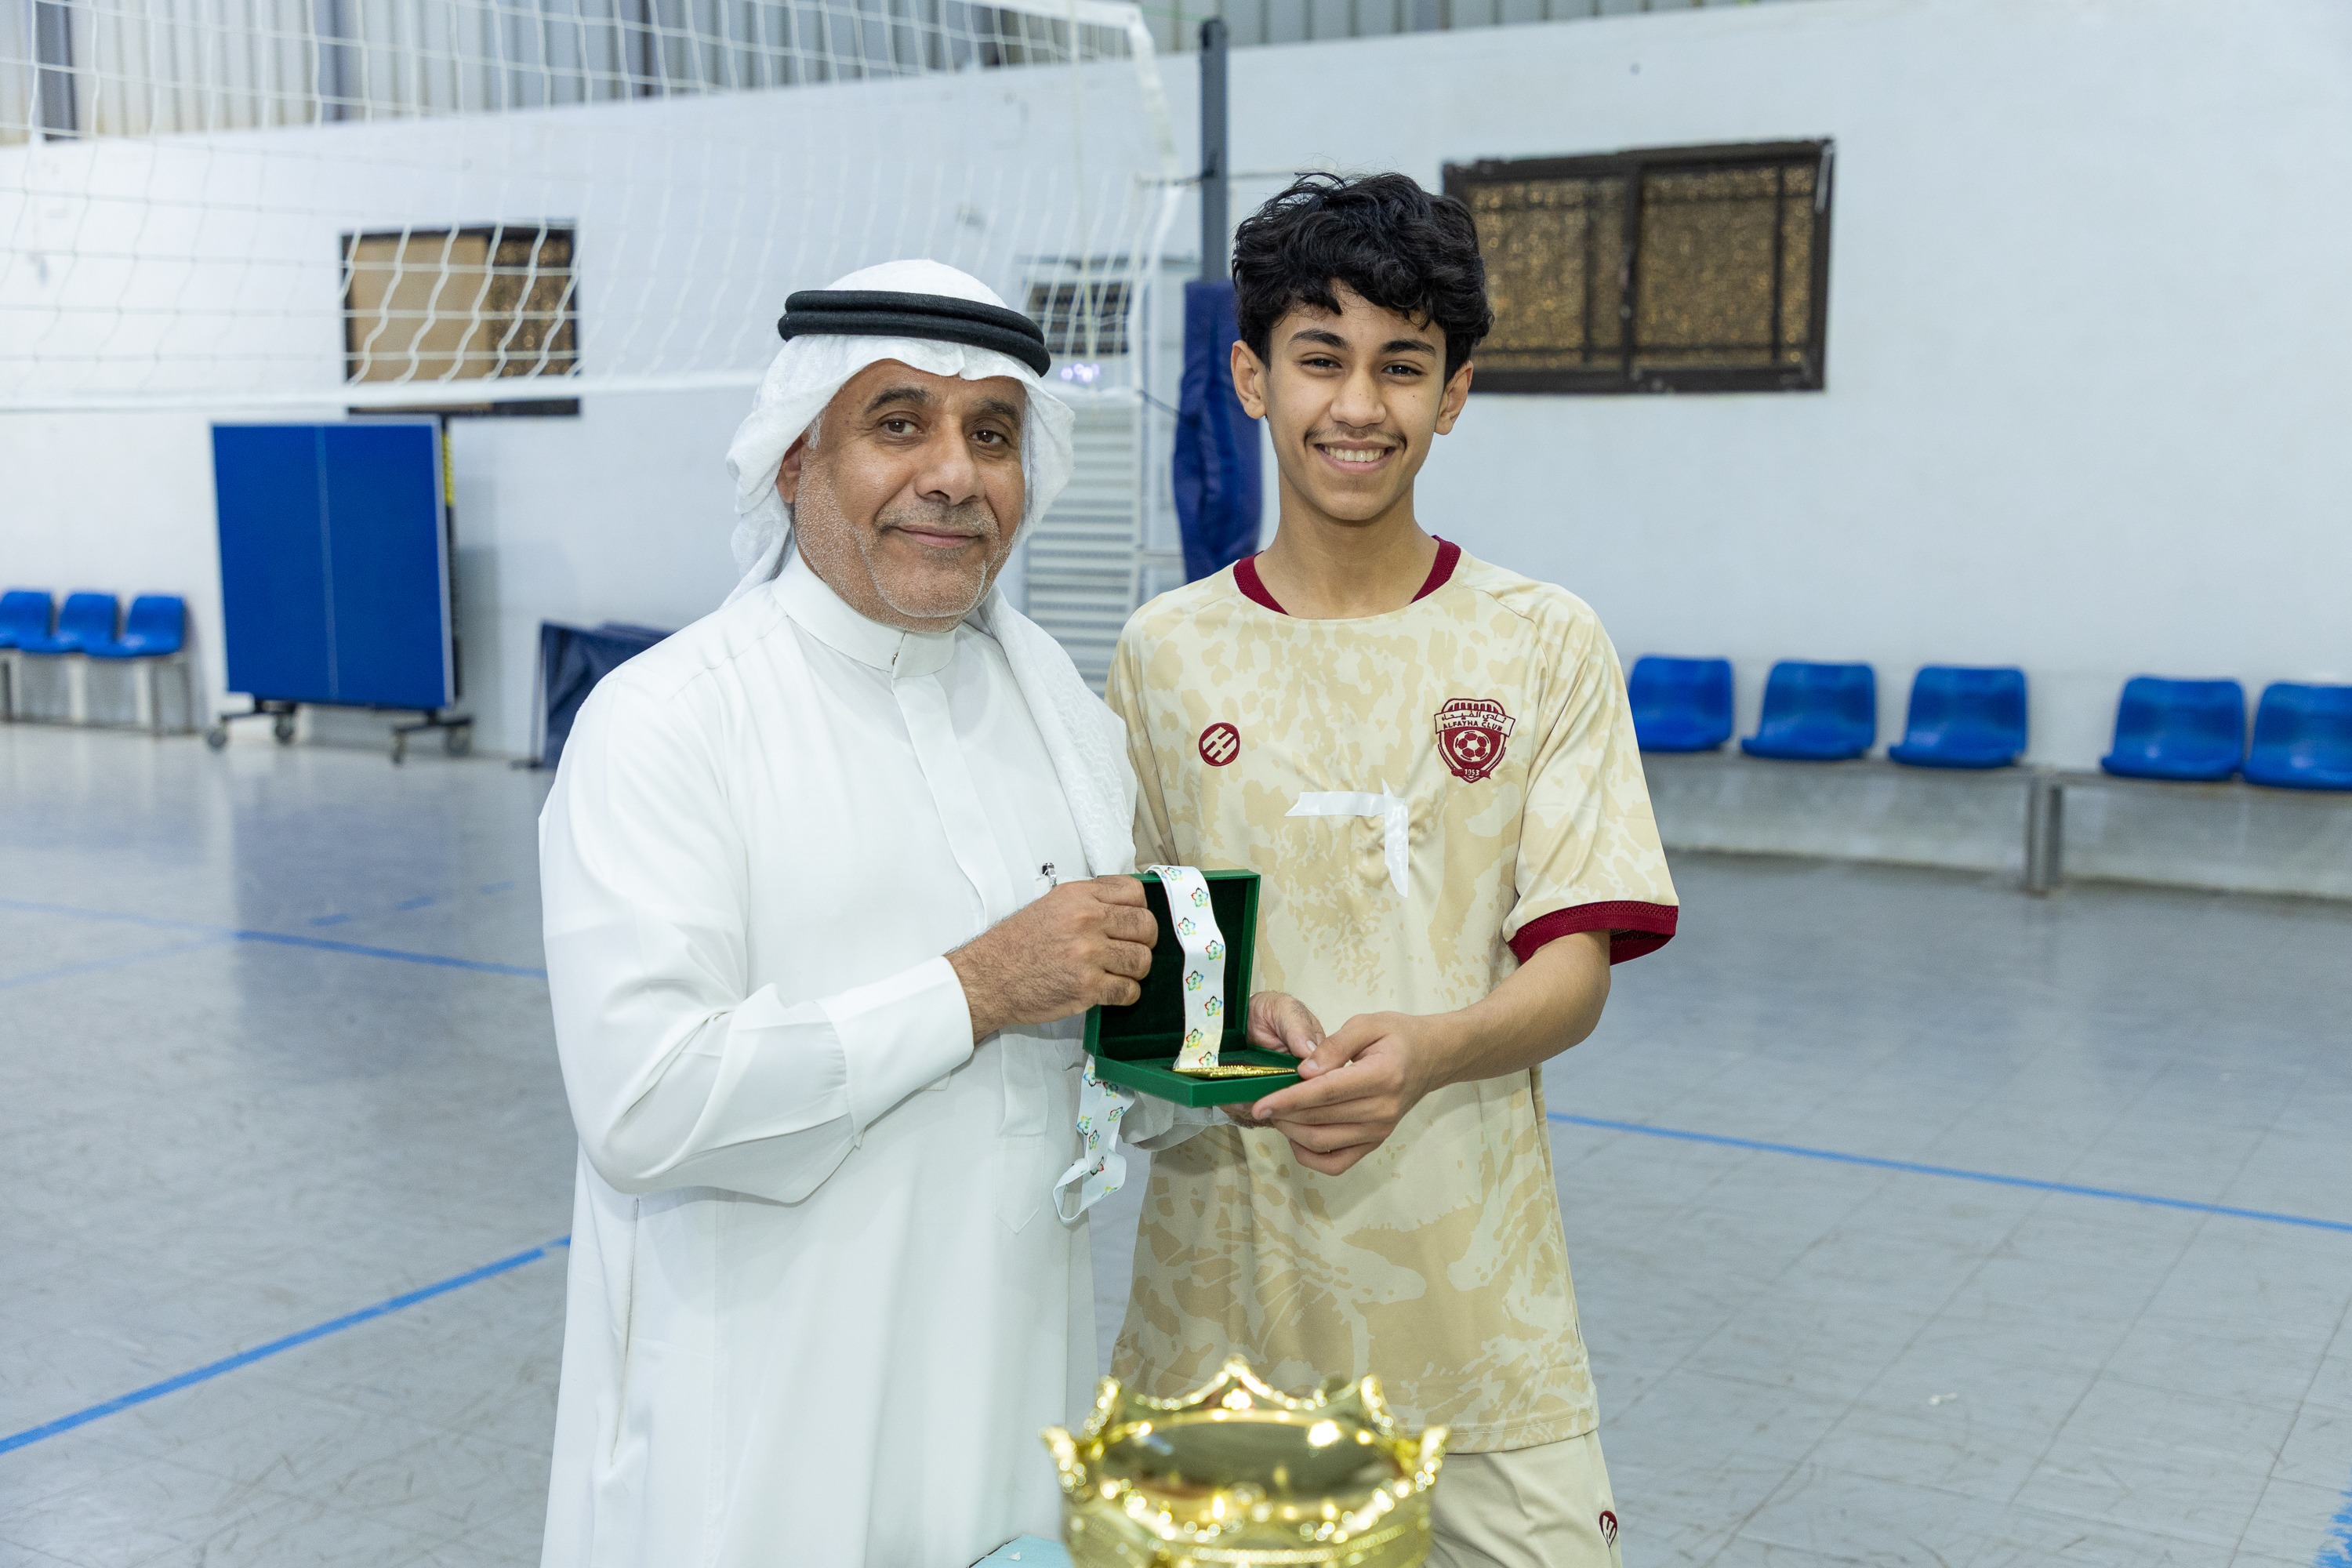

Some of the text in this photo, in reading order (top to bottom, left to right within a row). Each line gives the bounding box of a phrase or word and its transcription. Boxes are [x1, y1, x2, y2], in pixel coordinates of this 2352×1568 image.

[1442, 710, 1507, 724] نادي الفيحاء
[1443, 720, 1478, 729] ALFAYHA
